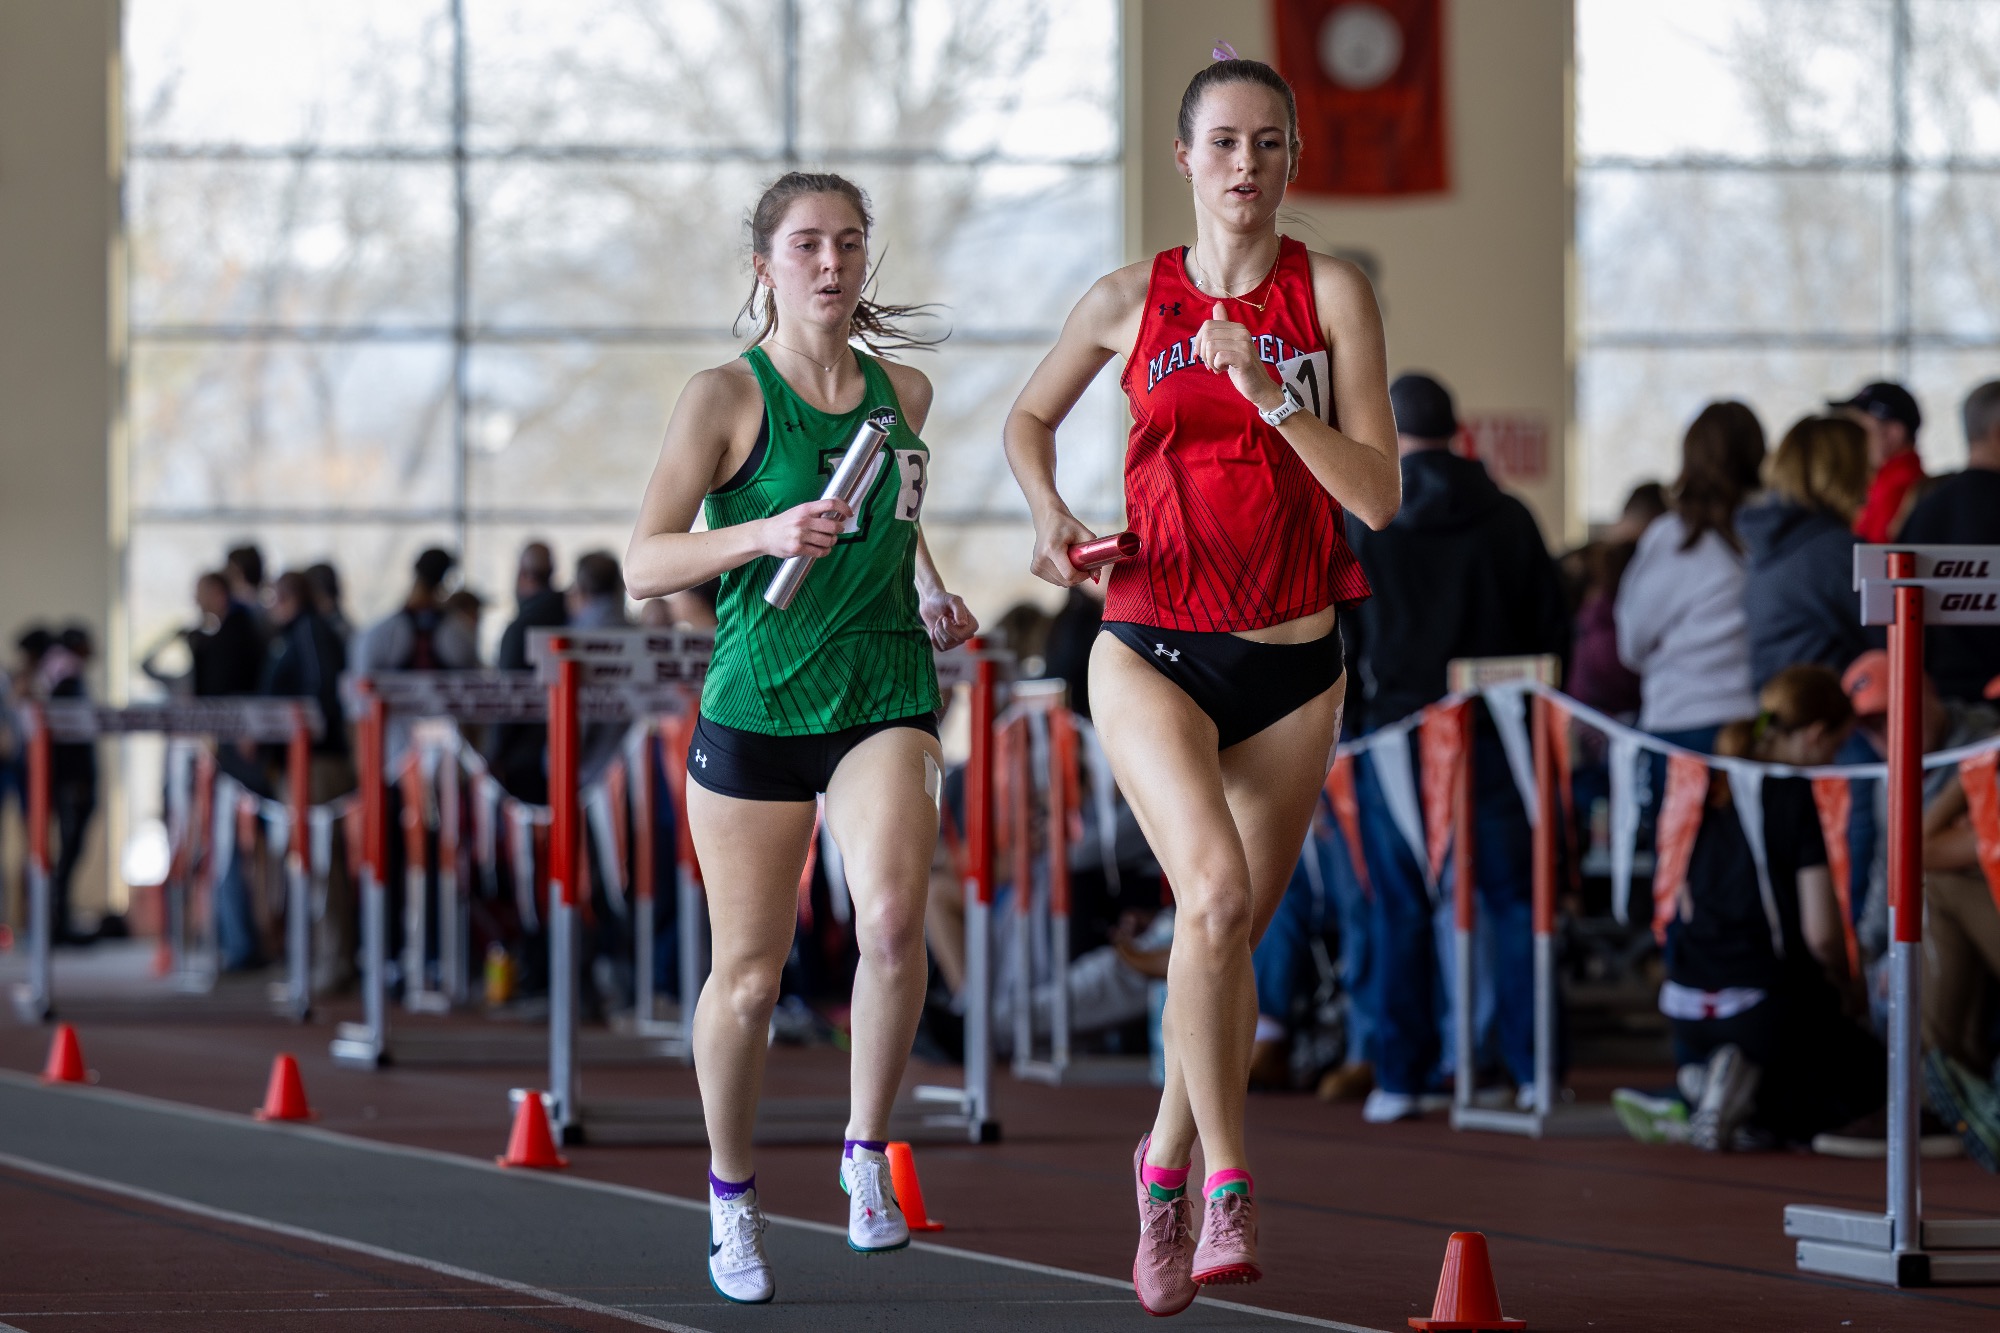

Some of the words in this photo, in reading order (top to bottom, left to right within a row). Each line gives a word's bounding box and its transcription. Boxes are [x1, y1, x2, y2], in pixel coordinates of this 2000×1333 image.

[905, 453, 923, 519] 3
[1932, 560, 1990, 578] GILL
[1940, 593, 1997, 611] GILL
